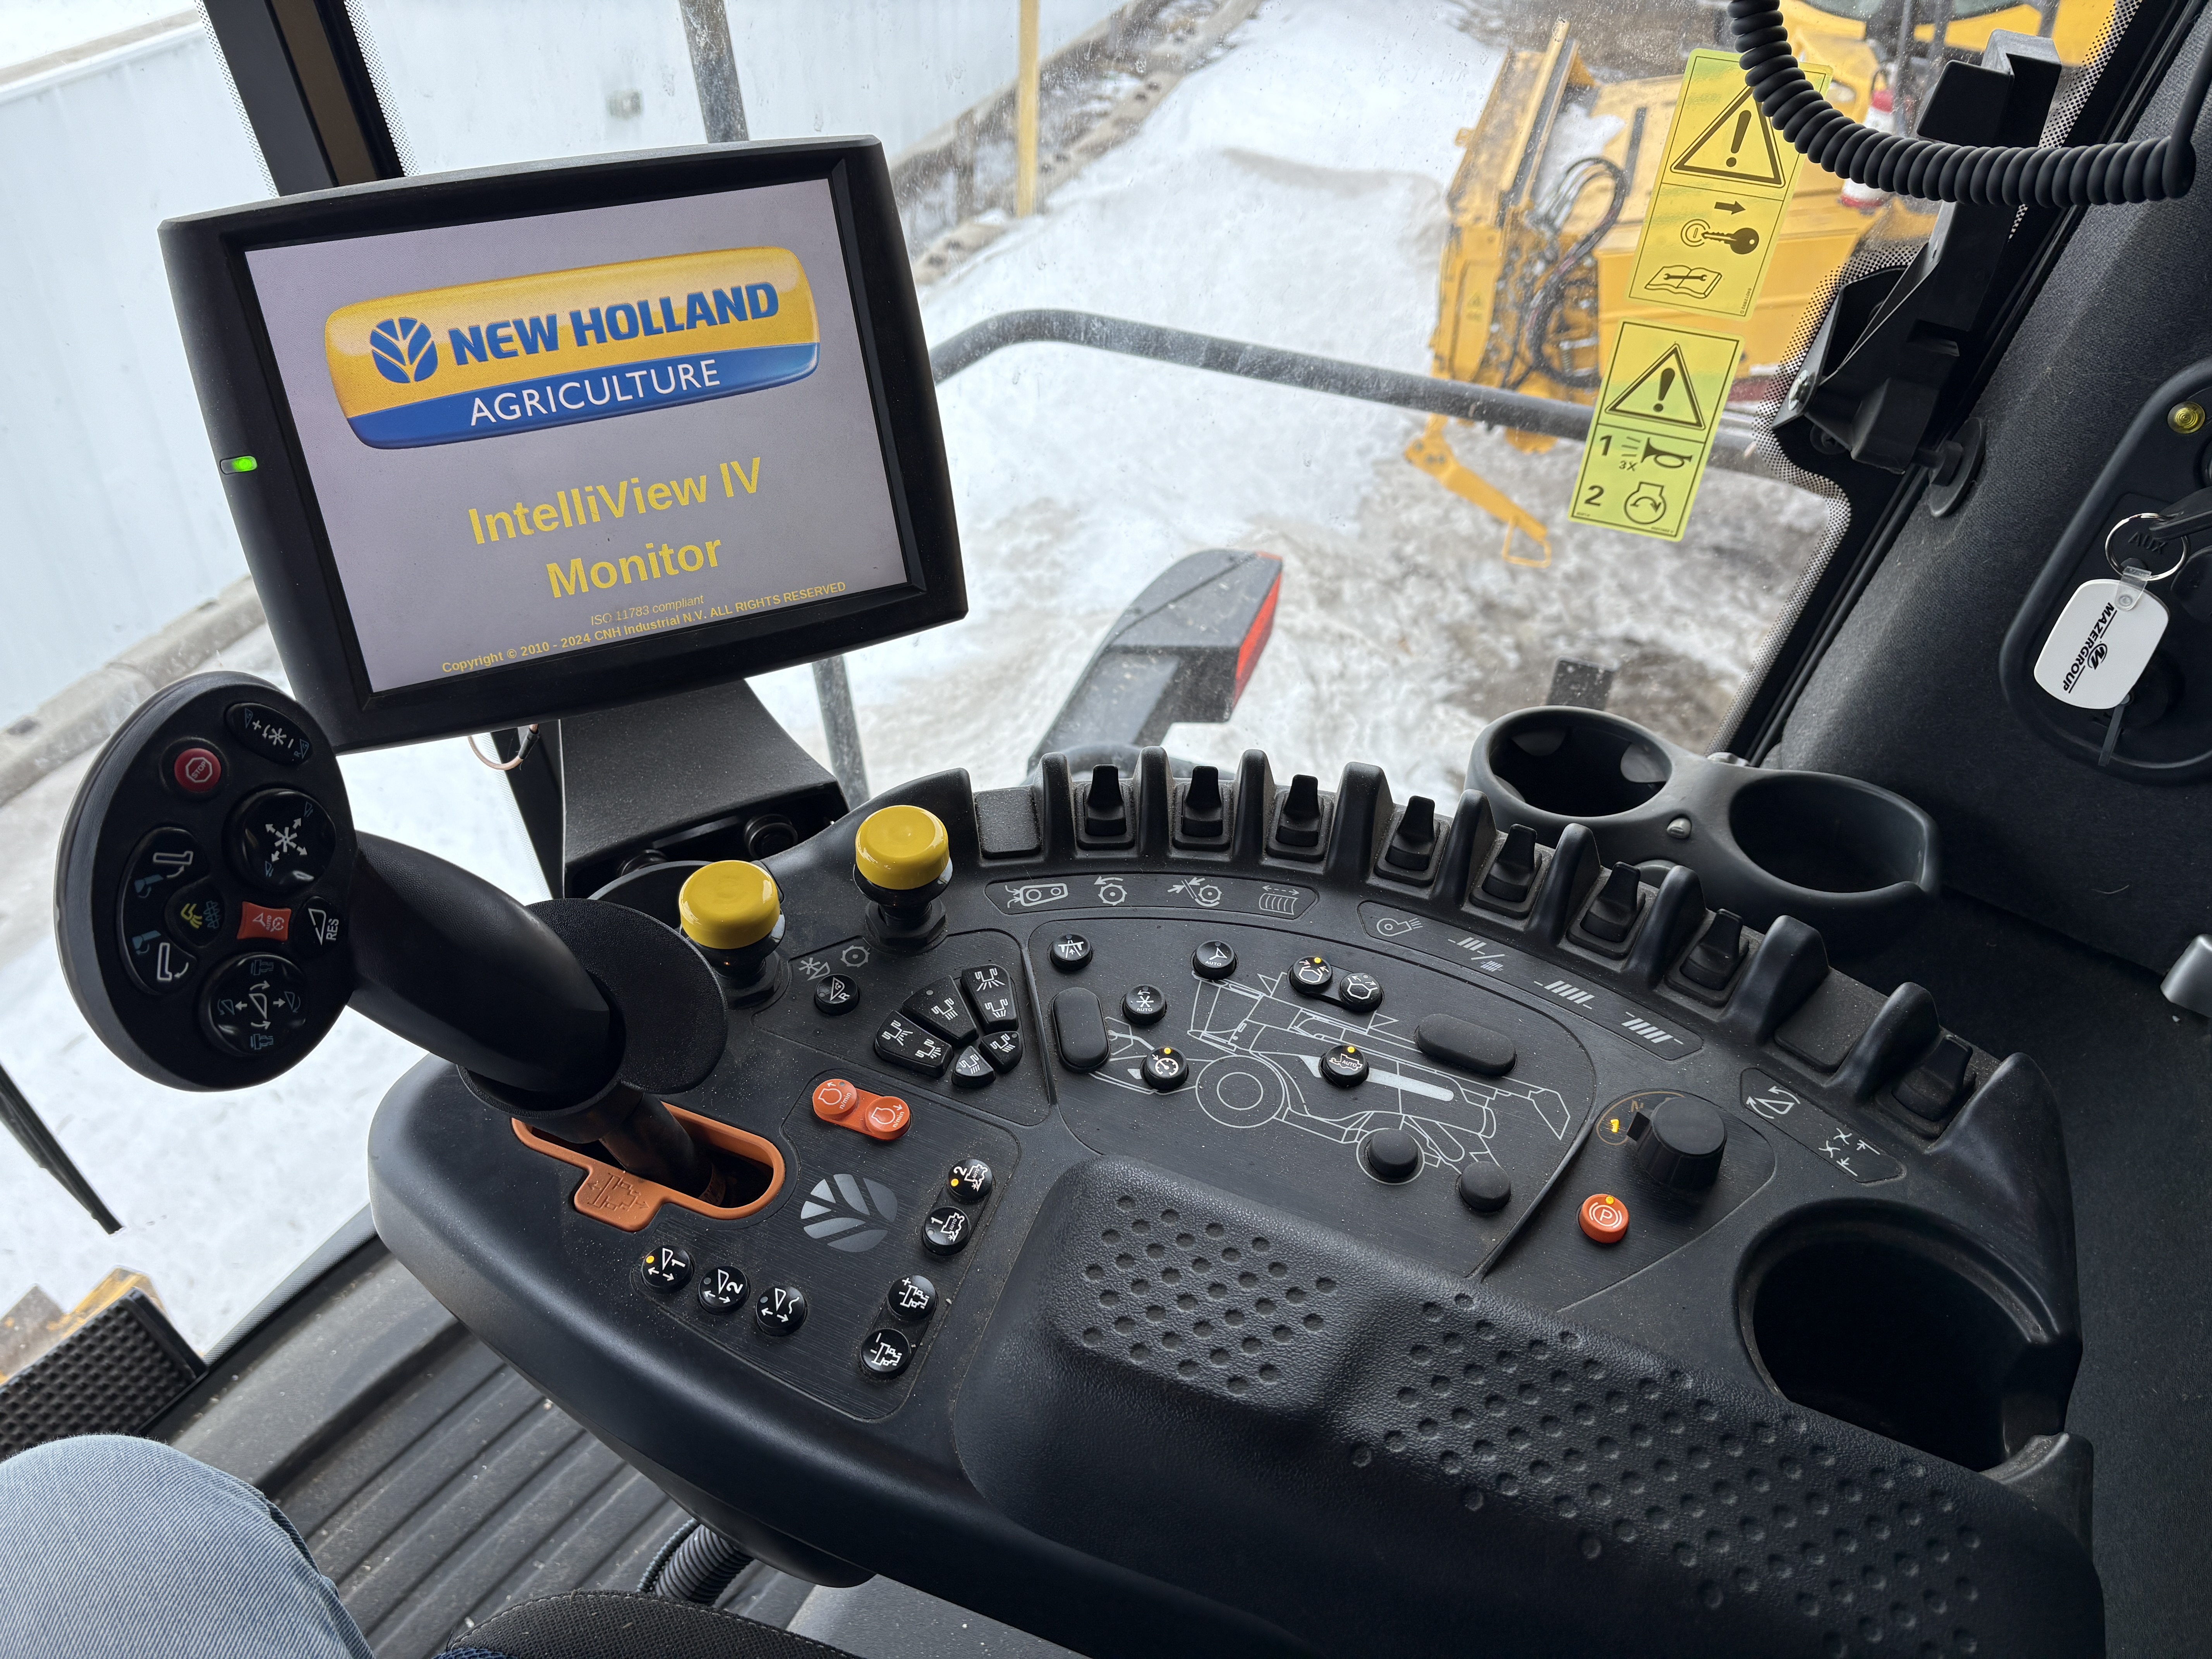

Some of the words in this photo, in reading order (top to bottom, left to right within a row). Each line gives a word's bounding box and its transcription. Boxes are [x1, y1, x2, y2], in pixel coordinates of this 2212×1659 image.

[448, 314, 560, 365] NEW
[569, 282, 779, 347] HOLLAND
[471, 359, 720, 426] AGRICULTURE
[1600, 434, 1612, 456] 1
[1619, 460, 1638, 471] 3X
[469, 475, 706, 544] IntelliView
[720, 457, 760, 498] IV
[1584, 485, 1604, 506] 2
[2128, 531, 2168, 554] AUX
[546, 539, 721, 598] Monitor
[591, 613, 611, 625] ISO
[616, 605, 649, 620] 11783
[653, 595, 704, 613] compliant
[442, 651, 504, 673] Copyright
[507, 649, 517, 658] ©
[521, 641, 550, 656] 2010
[561, 633, 591, 648] 2024
[594, 629, 622, 641] CNH
[624, 614, 680, 635] Industrial
[683, 610, 706, 623] N.V.
[710, 606, 733, 618] ALL
[735, 595, 781, 612] RIGHTS
[783, 582, 846, 602] RESERVED
[2063, 602, 2114, 691] MAZERGROUP
[191, 761, 206, 779] STOP
[326, 918, 339, 941] RES
[838, 992, 850, 1001] R
[839, 1092, 852, 1109] n/min
[893, 1111, 905, 1128] n/min
[953, 1166, 967, 1176] 2
[972, 1168, 980, 1180] AUTO
[949, 1218, 957, 1230] AUTO
[1600, 1208, 1613, 1221] P
[672, 1259, 685, 1267] 1
[726, 1281, 744, 1294] 2
